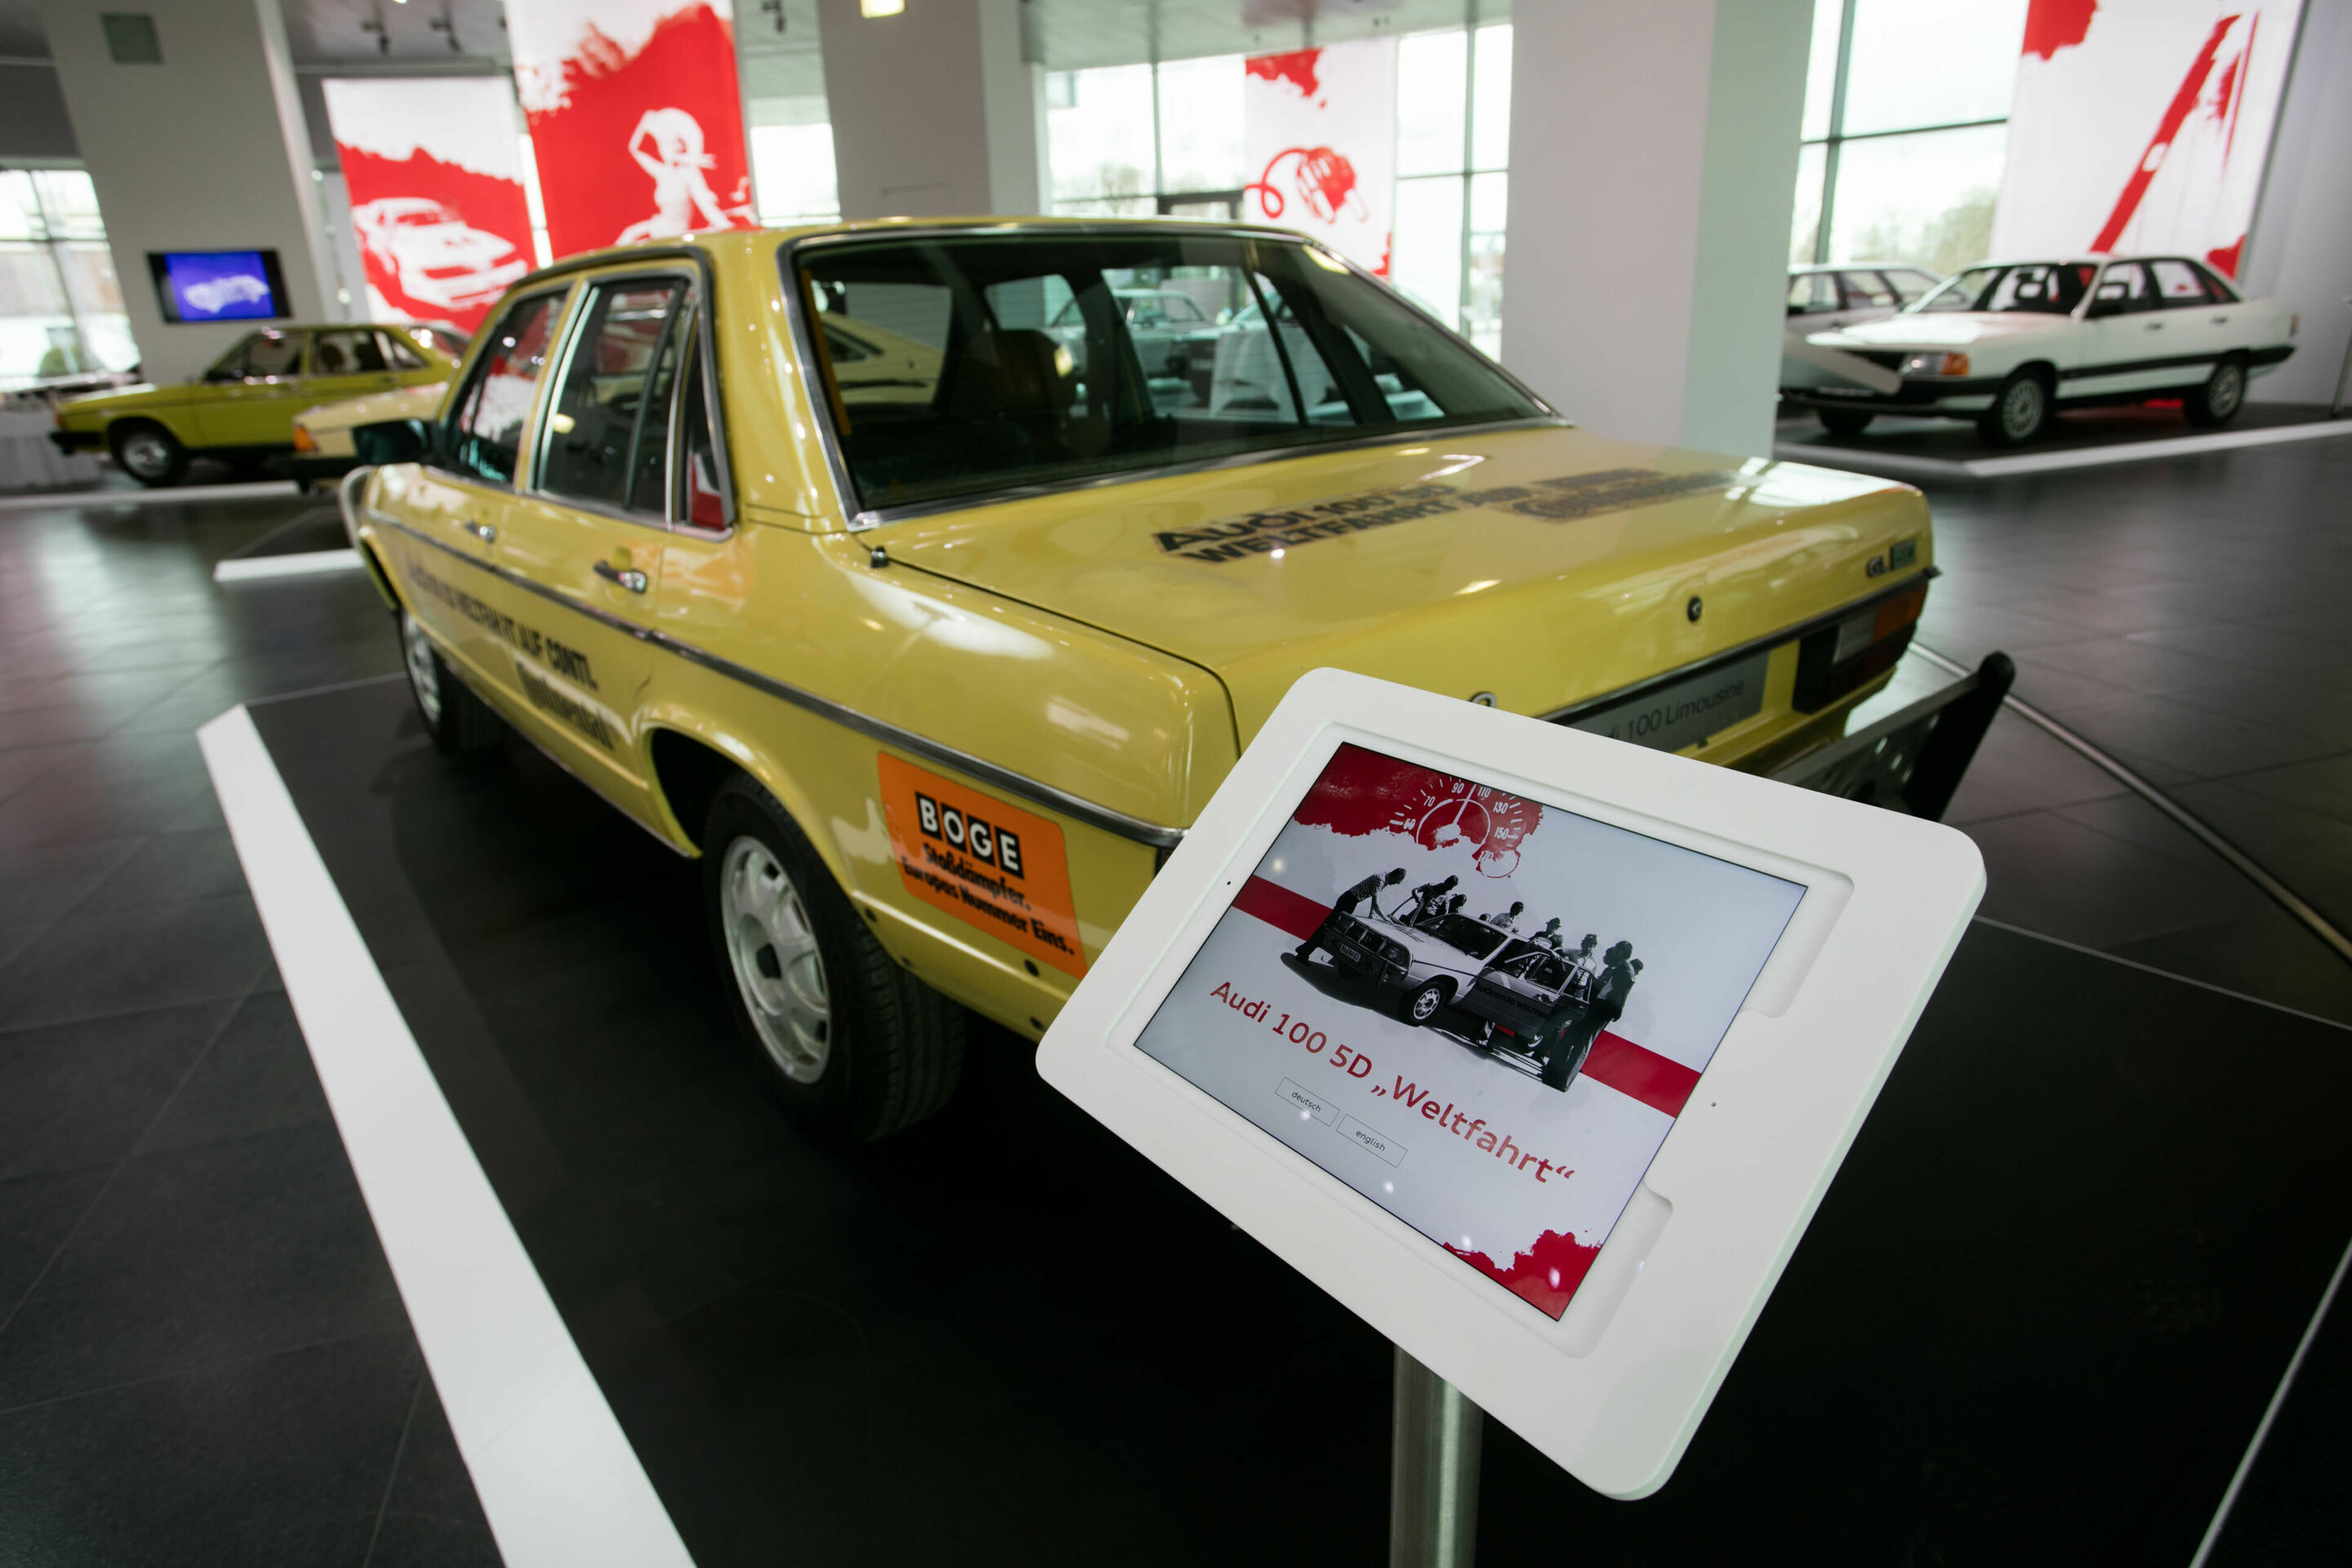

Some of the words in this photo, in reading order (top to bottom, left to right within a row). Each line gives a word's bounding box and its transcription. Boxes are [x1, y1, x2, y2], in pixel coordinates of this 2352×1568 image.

[1154, 510, 1310, 552] AUDI
[1312, 493, 1396, 514] 100
[1181, 498, 1460, 564] WELTFAHRT
[1628, 709, 1663, 742] 100
[1666, 679, 1745, 726] Limousine
[1423, 796, 1436, 807] 70
[1451, 782, 1464, 794] 90
[1477, 786, 1491, 798] 110
[1493, 801, 1508, 814] 130
[918, 796, 1020, 872] BOGE
[1494, 827, 1509, 840] 150
[923, 843, 1031, 911] Stoßdämpfer.
[902, 856, 960, 899] Europas
[959, 884, 1027, 933] Nummer
[1030, 918, 1075, 956] Eins.
[1210, 982, 1272, 1024] Audi
[1272, 1013, 1327, 1054] 100
[1329, 1044, 1373, 1079] 5D
[1291, 1090, 1322, 1113] deutsch
[1355, 1129, 1387, 1152] english
